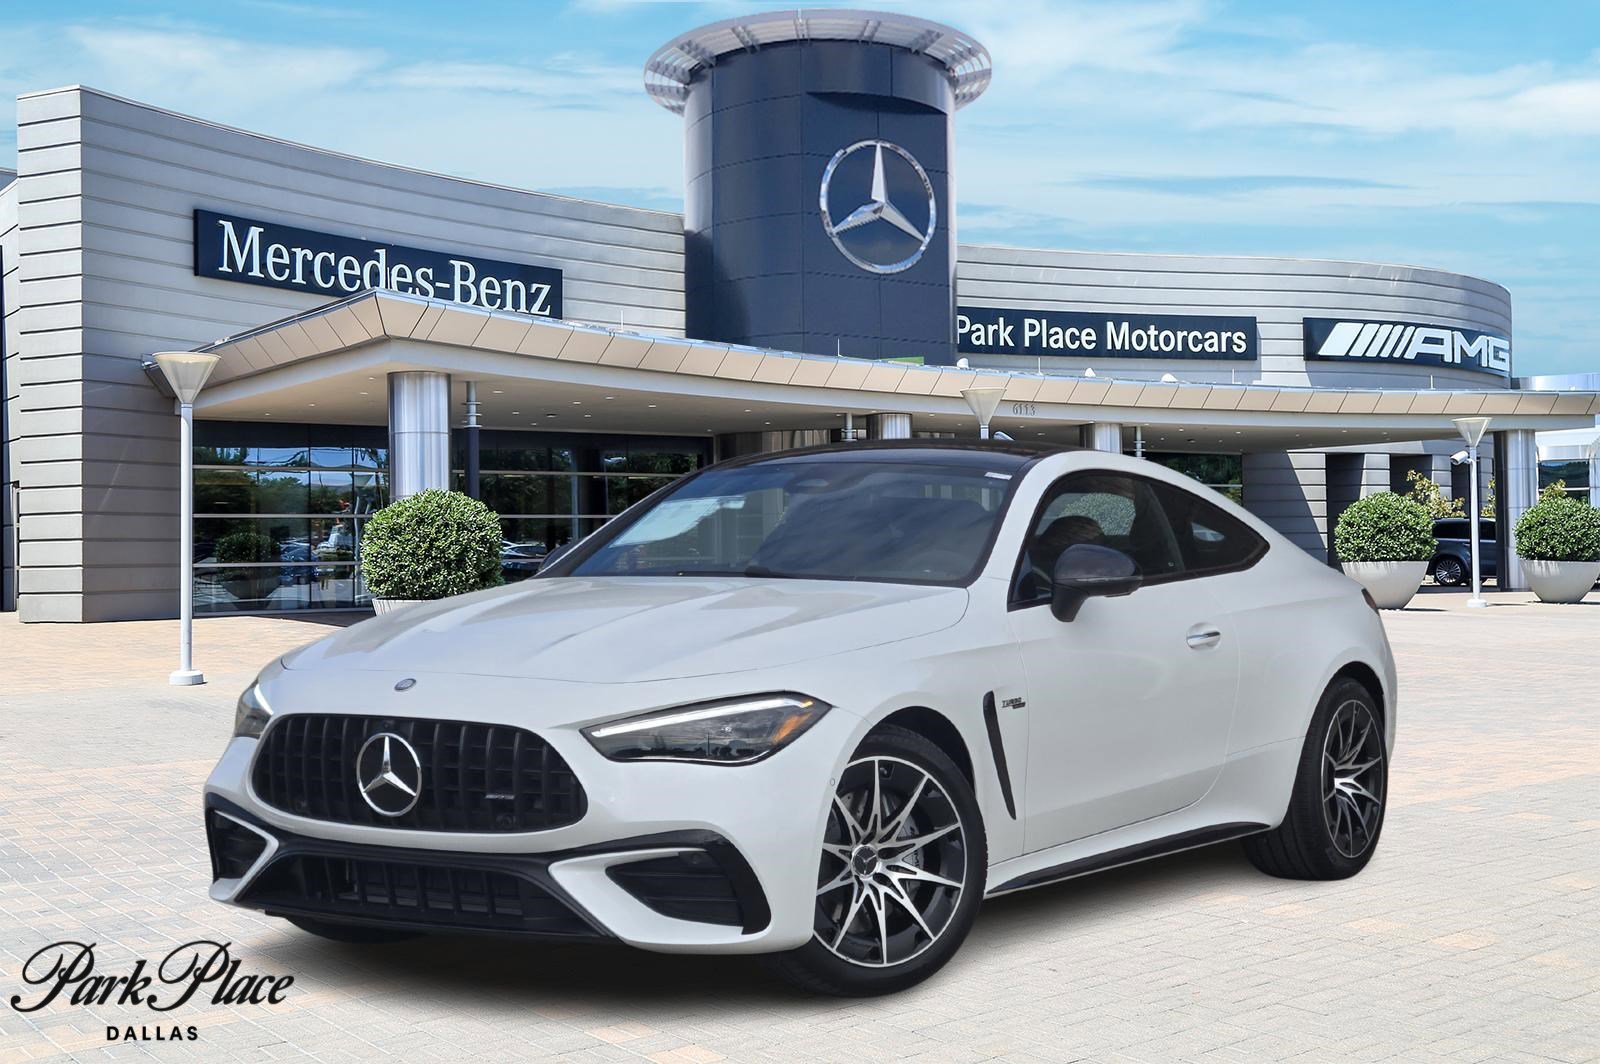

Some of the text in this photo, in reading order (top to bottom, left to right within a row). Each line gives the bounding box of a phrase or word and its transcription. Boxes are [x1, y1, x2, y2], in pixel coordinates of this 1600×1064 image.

[218, 219, 551, 316] Mercedes-Benz
[956, 314, 1248, 353] Park Place Motorcars
[1404, 326, 1510, 372] AMG
[1012, 402, 1036, 417] 6113
